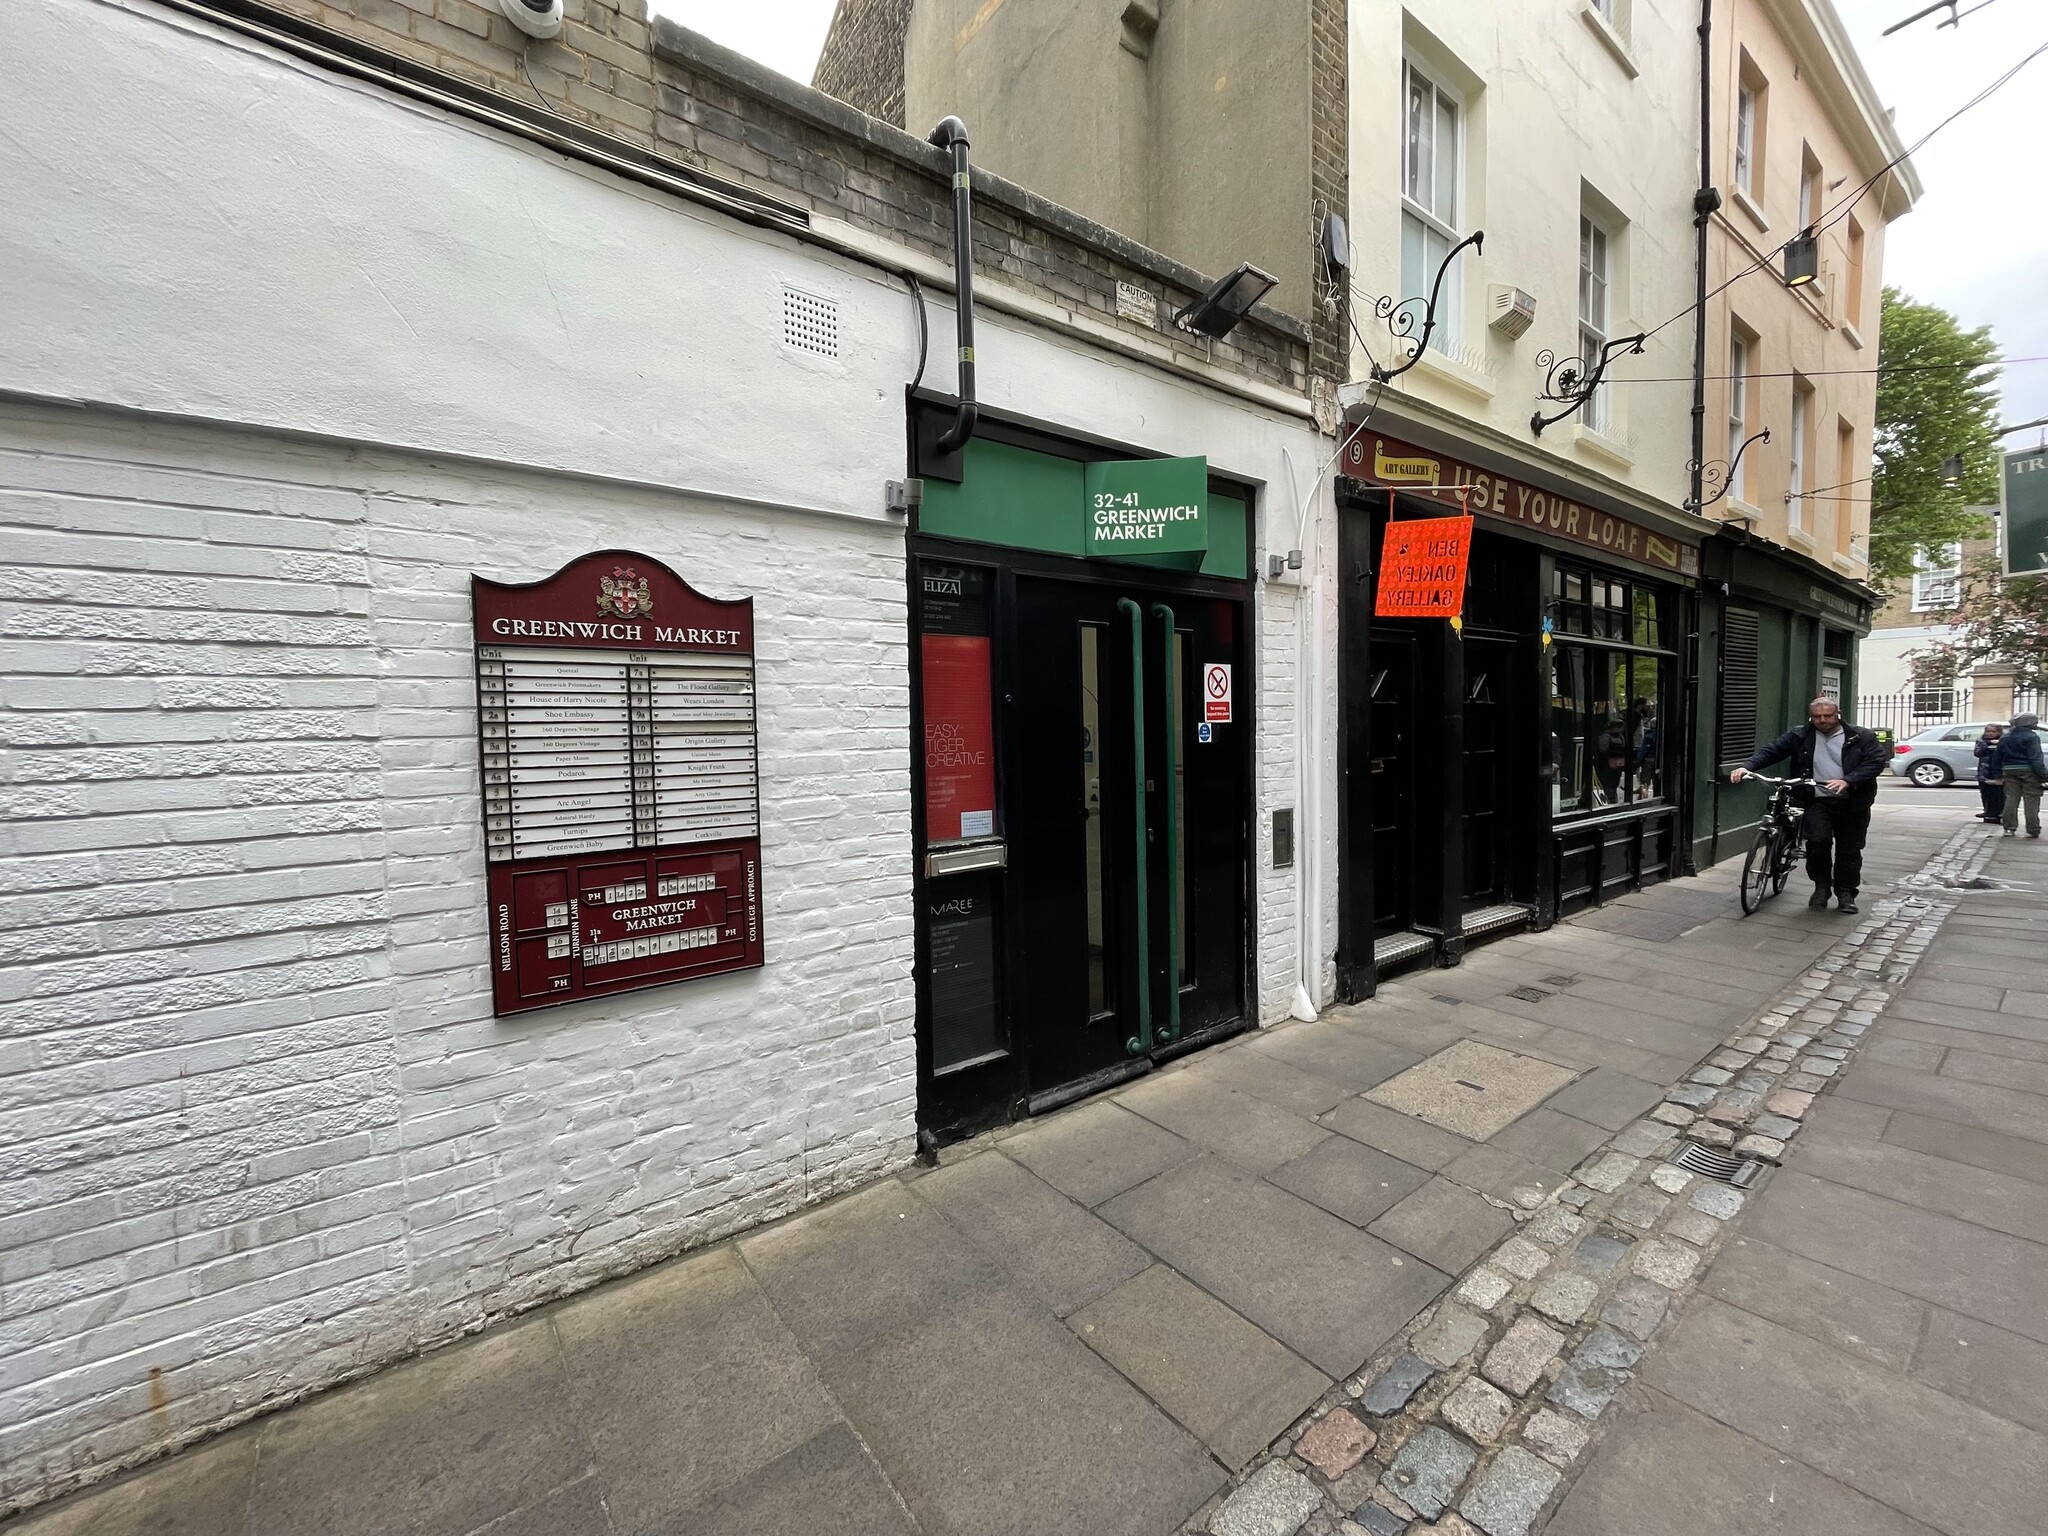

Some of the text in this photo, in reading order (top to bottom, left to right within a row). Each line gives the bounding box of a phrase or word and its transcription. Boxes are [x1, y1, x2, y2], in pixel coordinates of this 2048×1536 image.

[1120, 283, 1152, 302] CAUTION
[1353, 442, 1361, 461] 9
[1383, 463, 1430, 476] ART GALLERY
[2010, 457, 2048, 474] TR
[1094, 492, 1139, 508] 32-41
[1454, 465, 1640, 553] USE YOUR LOAF
[1094, 505, 1198, 525] GREENWICH
[1094, 524, 1165, 541] MARKET
[923, 580, 958, 594] ELIZA
[492, 618, 741, 645] GREENWICH MARKET
[481, 649, 502, 658] Unit
[629, 654, 647, 663] Unit
[486, 681, 496, 689] 1a
[489, 696, 496, 704] 2
[563, 696, 583, 704] Harry
[637, 697, 643, 705] 9
[488, 711, 499, 719] 2a
[564, 711, 594, 719] Embassy
[636, 725, 646, 733] 10
[925, 723, 960, 739] EASY
[634, 739, 648, 747] 10a
[926, 738, 965, 753] TIGER
[926, 751, 985, 767] CREATIVE
[639, 780, 648, 789] 12
[563, 828, 588, 836] Turnips
[640, 822, 650, 831] 16
[547, 843, 585, 852] Greenwich
[588, 892, 601, 901] PH
[747, 860, 757, 942] COLLEGE APPROACH
[612, 899, 696, 921] GREENWICH
[626, 913, 684, 932] MARKET
[570, 898, 580, 959] TURNPIN LANE
[725, 928, 736, 937] PH
[499, 904, 511, 971] NELSON ROAD
[621, 947, 630, 955] 10
[554, 979, 568, 988] PH
